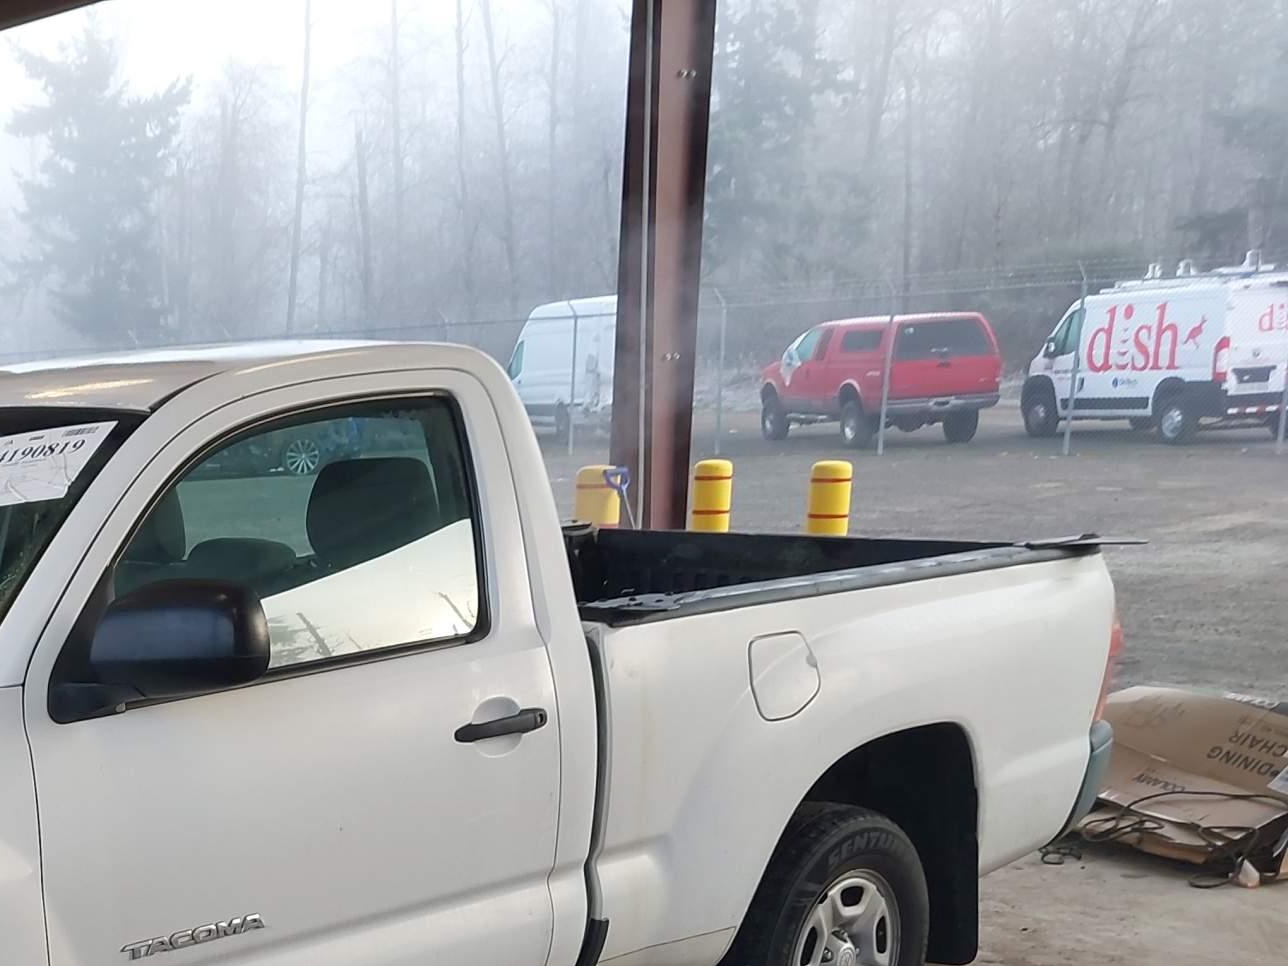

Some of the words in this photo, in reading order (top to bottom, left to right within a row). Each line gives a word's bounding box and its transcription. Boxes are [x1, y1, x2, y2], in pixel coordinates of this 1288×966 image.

[1086, 302, 1180, 373] dish
[1207, 746, 1275, 778] DINING
[1228, 730, 1288, 758] CHAIR
[120, 912, 266, 961] TACOMA
